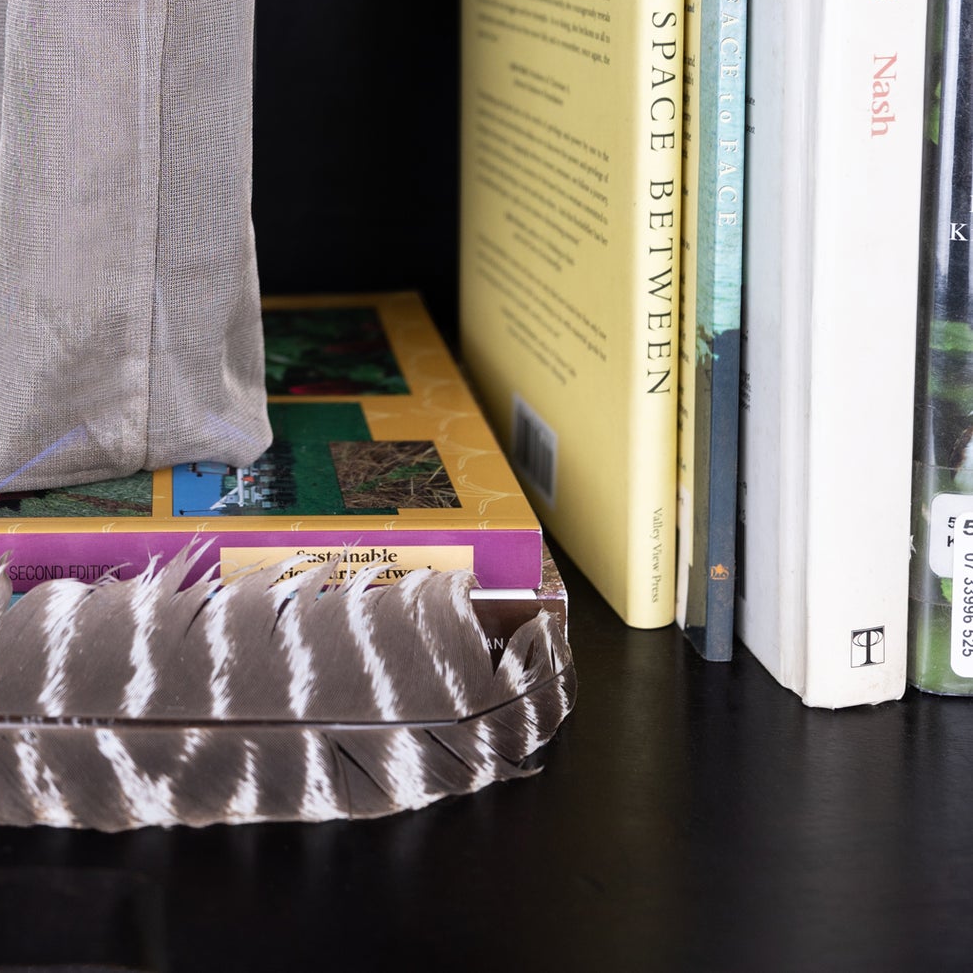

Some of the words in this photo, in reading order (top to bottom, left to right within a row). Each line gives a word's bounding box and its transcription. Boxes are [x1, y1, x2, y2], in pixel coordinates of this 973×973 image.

[650, 11, 677, 152] SPACE
[870, 52, 898, 139] Nash
[718, 92, 735, 124] to
[718, 138, 739, 228] FACE
[647, 177, 674, 395] BETWEEN
[649, 507, 664, 540] Valley
[9, 564, 64, 581] SECOND
[69, 564, 121, 580] EDITION
[652, 543, 663, 572] View
[651, 574, 662, 604] Press
